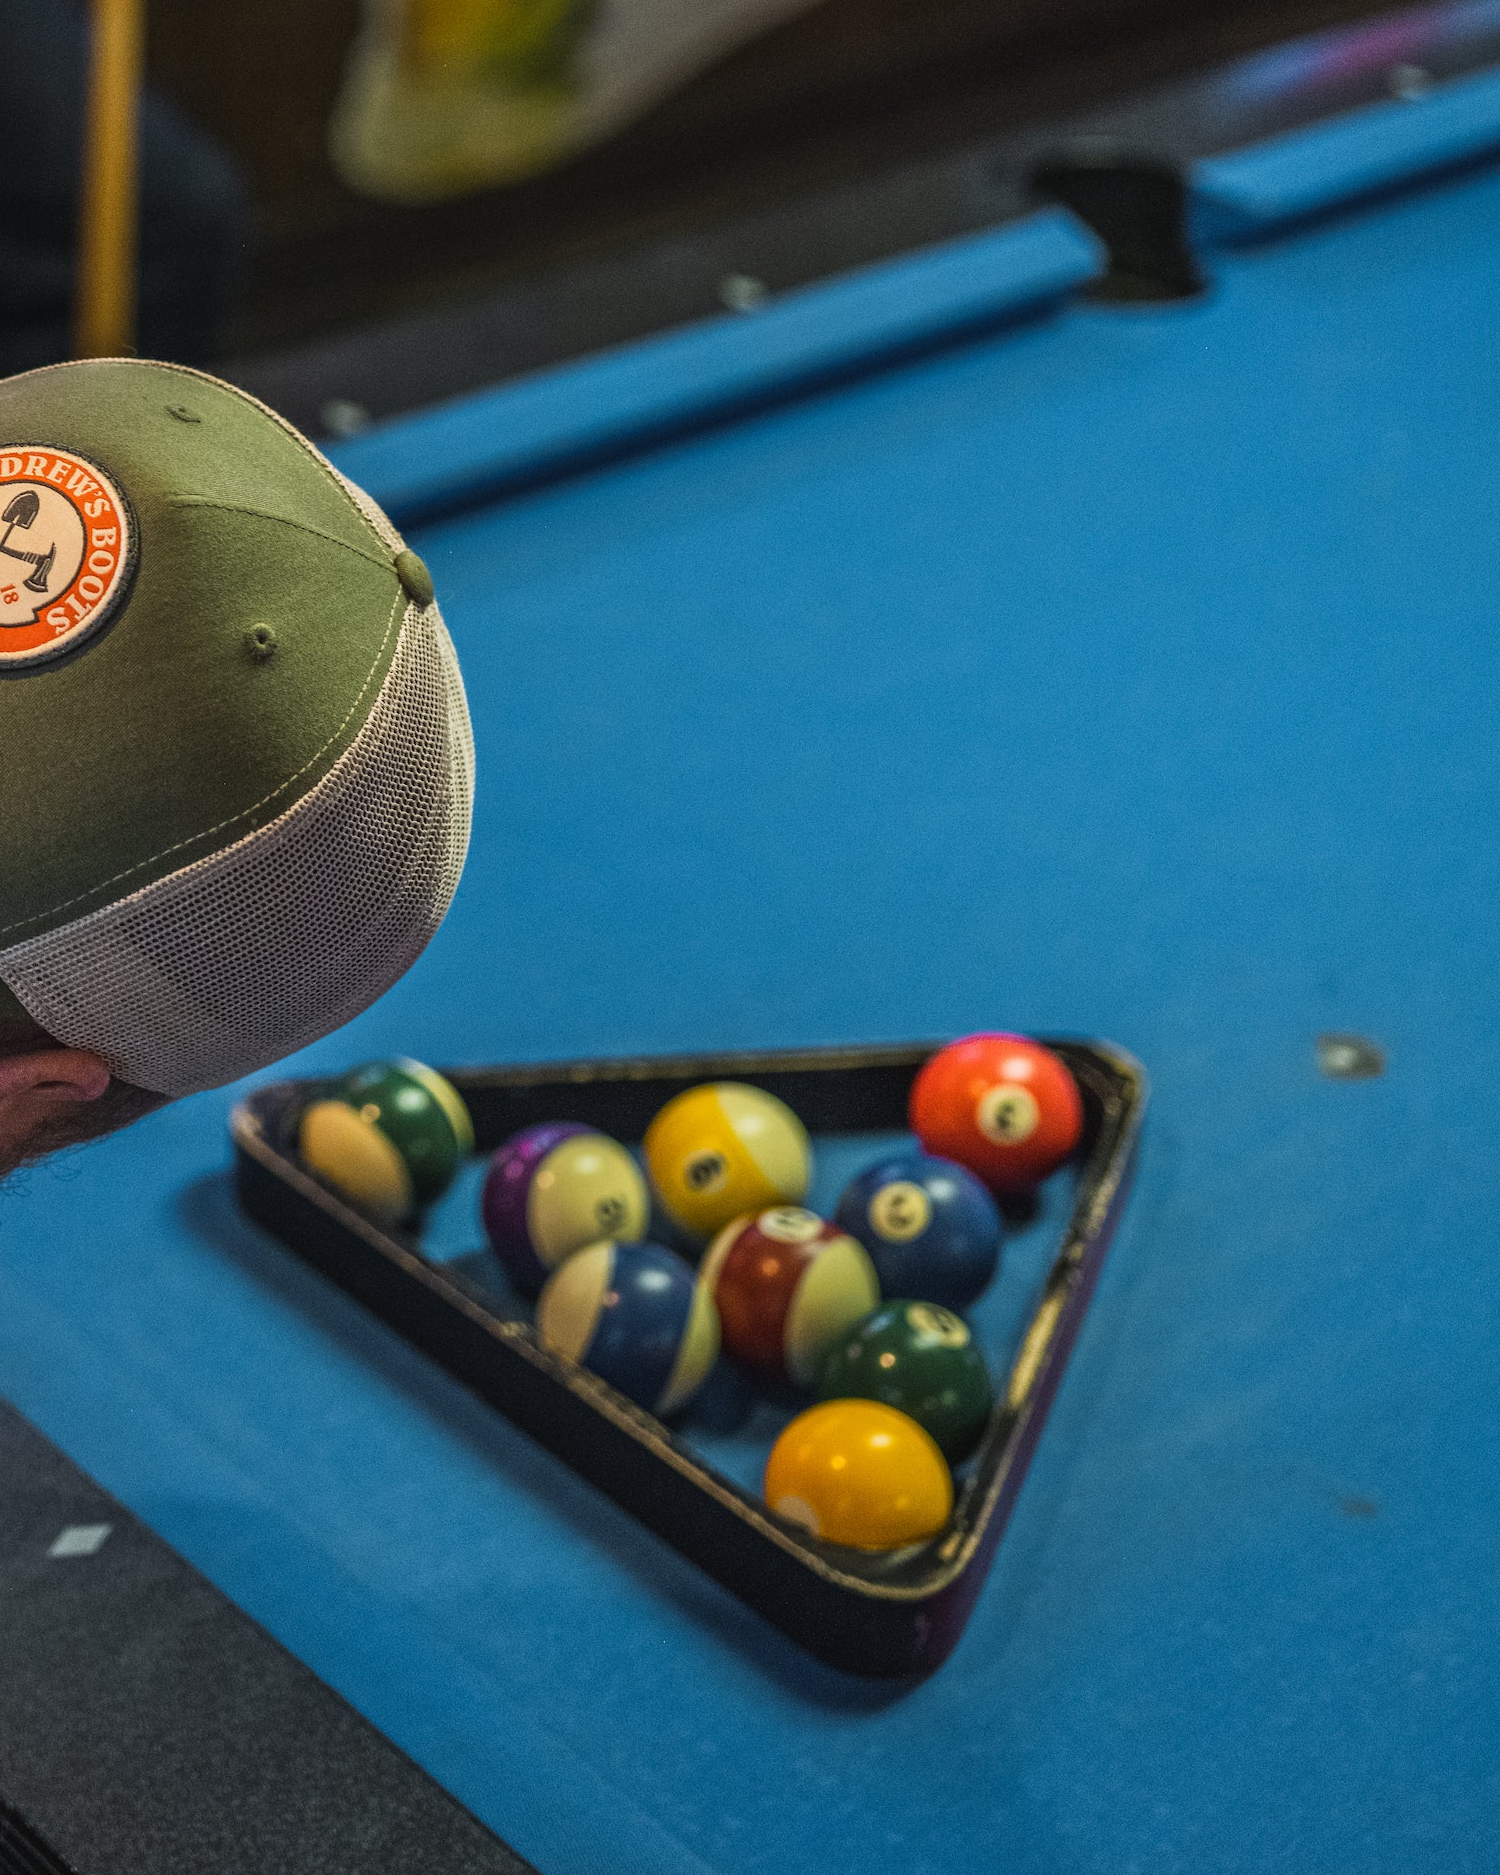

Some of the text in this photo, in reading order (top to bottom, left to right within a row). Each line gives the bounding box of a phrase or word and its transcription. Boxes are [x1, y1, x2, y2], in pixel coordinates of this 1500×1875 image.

[0, 454, 117, 636] DREW'S BOOTS
[0, 583, 19, 605] 18
